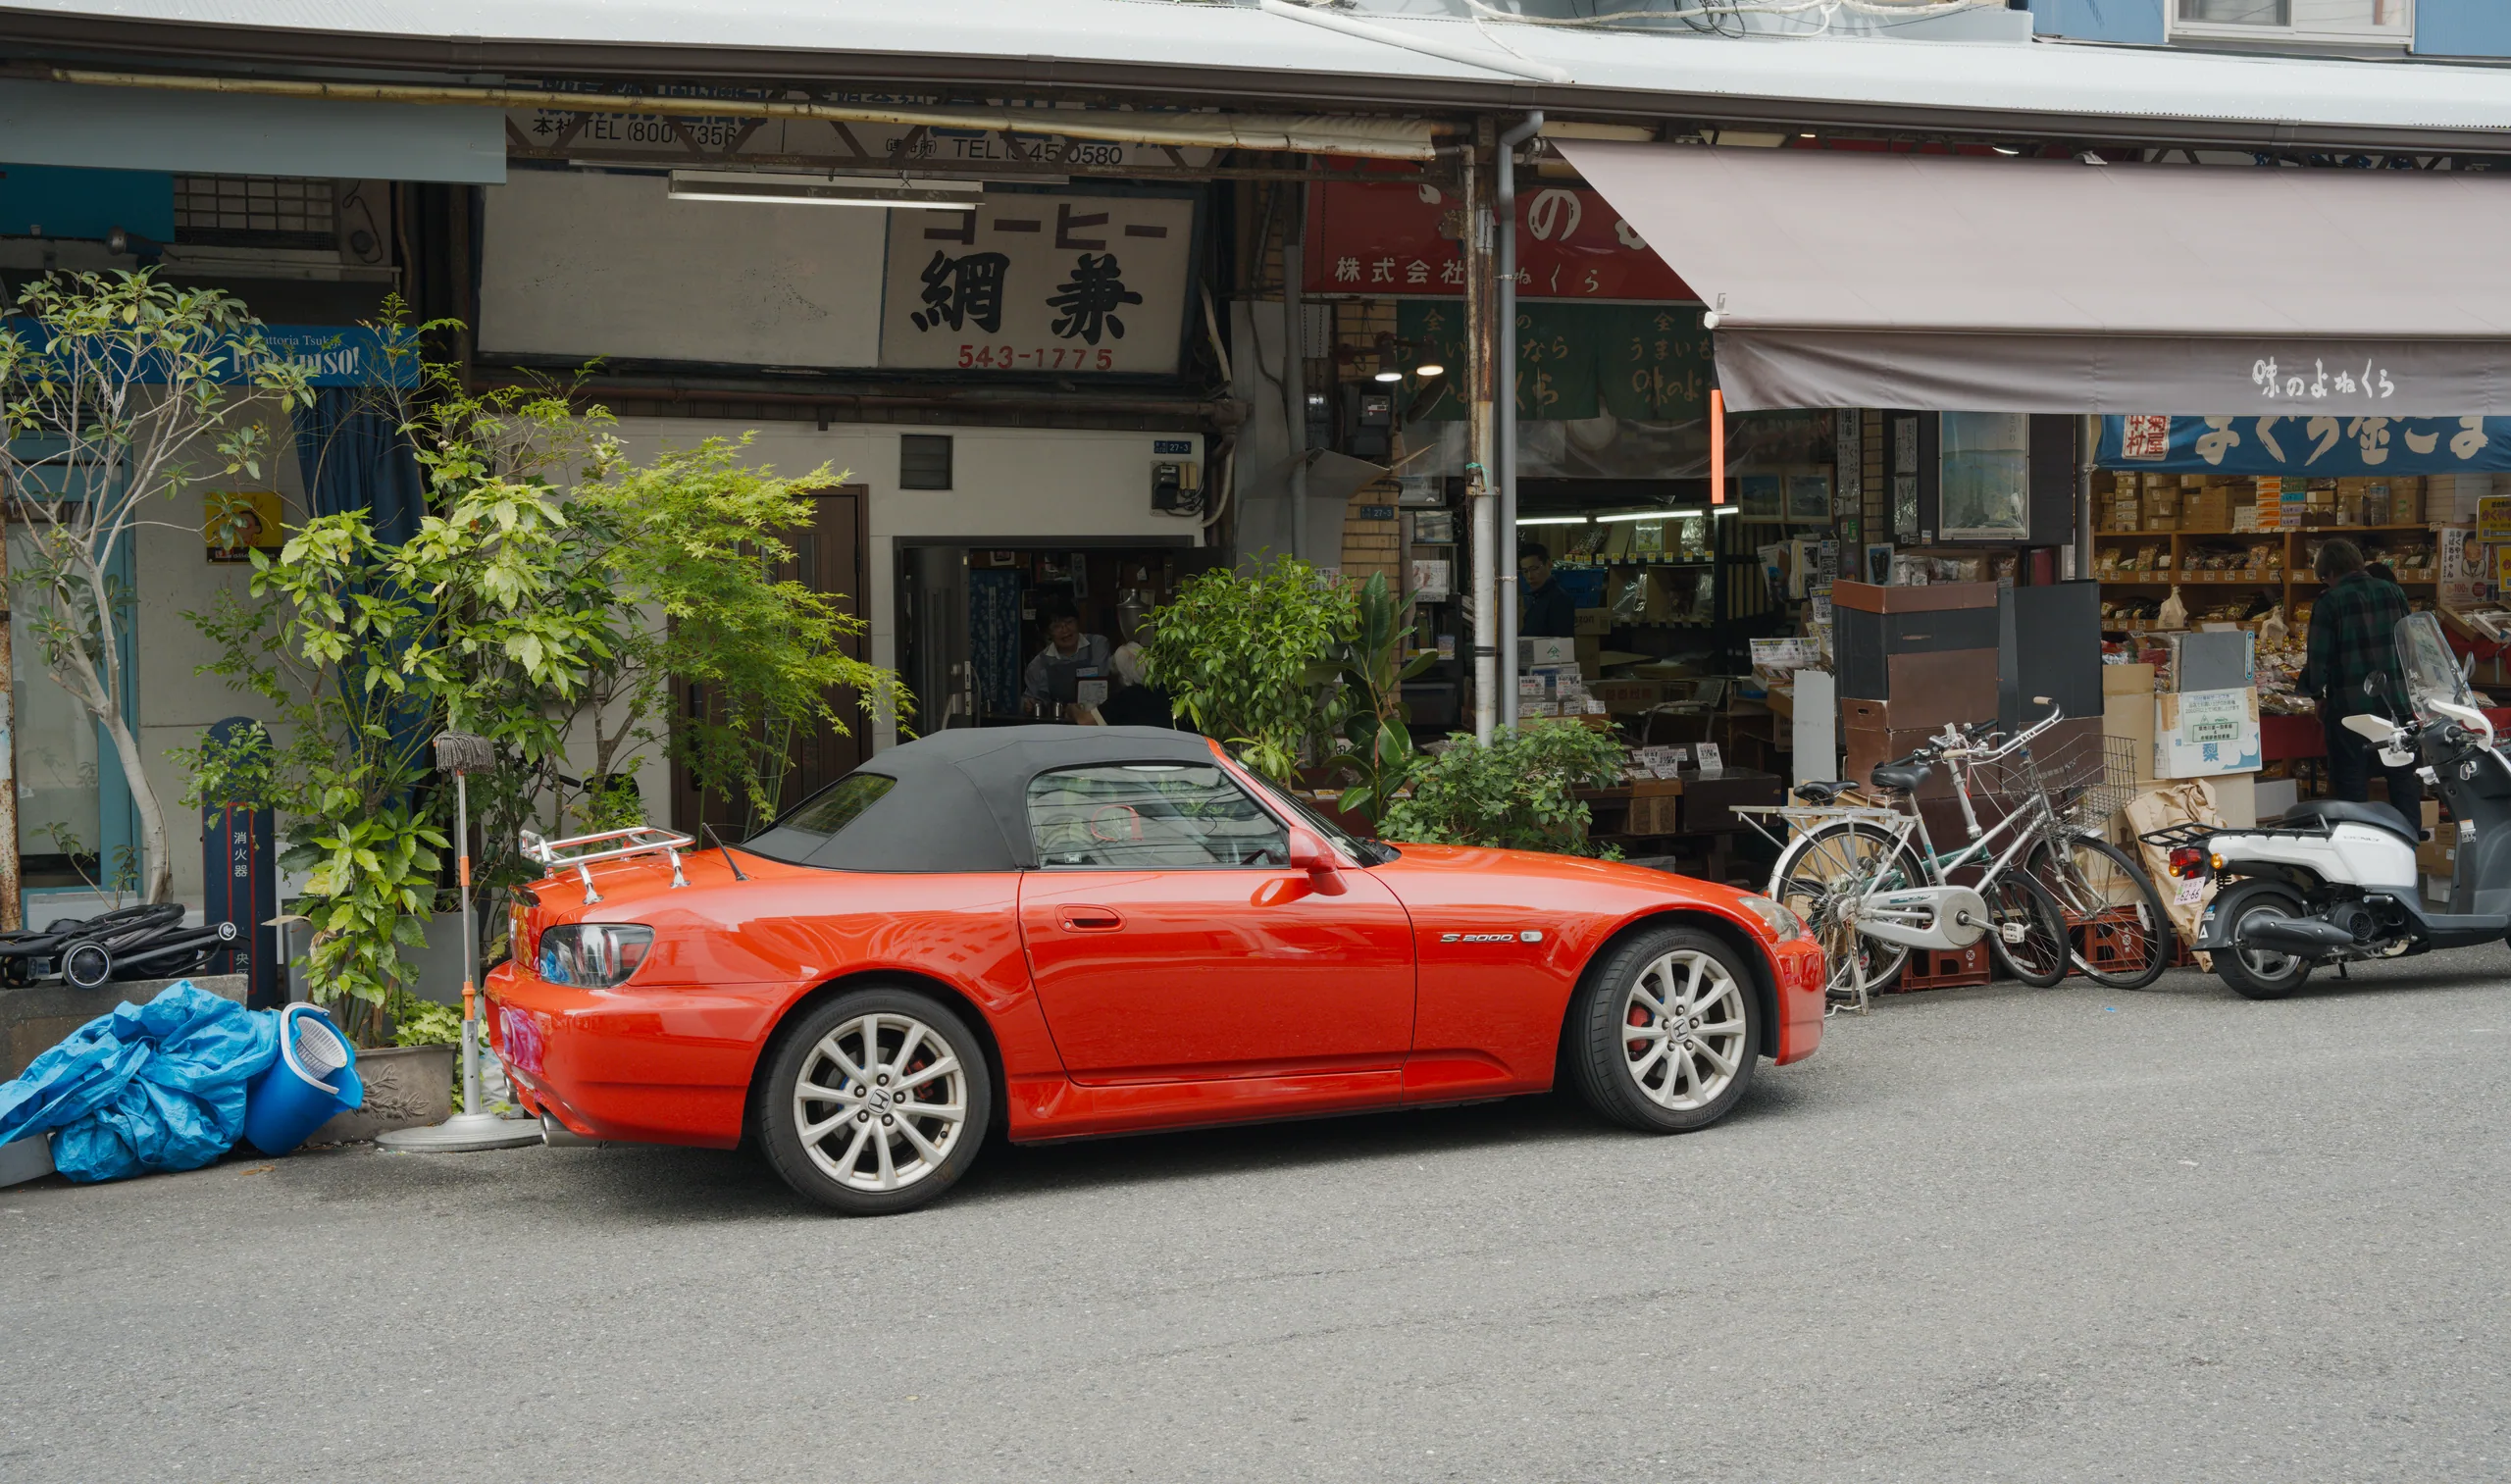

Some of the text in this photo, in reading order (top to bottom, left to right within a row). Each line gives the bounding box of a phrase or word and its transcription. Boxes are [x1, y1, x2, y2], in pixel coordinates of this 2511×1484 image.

[583, 120, 622, 140] TEL
[952, 138, 1000, 159] TEL
[924, 203, 1168, 251] コーヒー
[1334, 256, 1464, 285] 株式会社
[910, 249, 1144, 345] 網兼
[957, 344, 1113, 370] 543-1775
[2252, 356, 2396, 399] 味のよねくら
[1169, 443, 1190, 452] 27-3
[233, 832, 247, 877] 消火器
